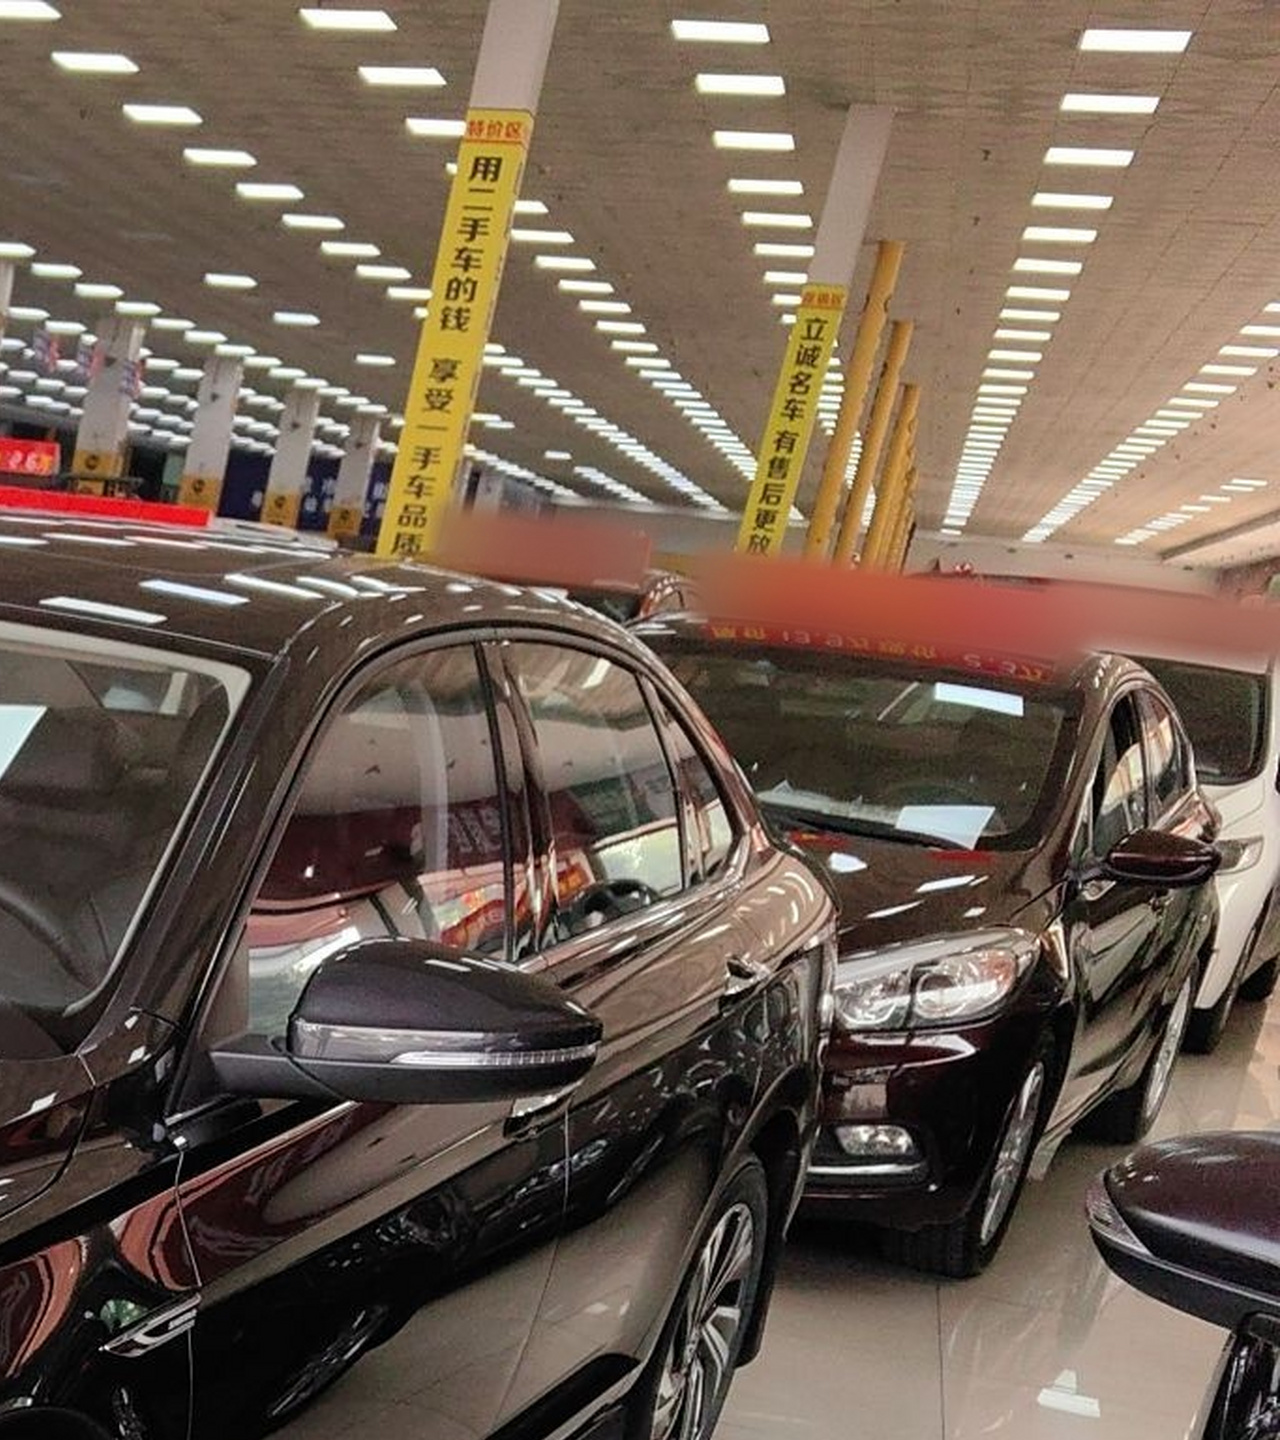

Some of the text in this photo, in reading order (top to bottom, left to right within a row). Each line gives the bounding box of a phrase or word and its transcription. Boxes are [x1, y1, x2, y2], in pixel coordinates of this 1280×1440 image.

[467, 119, 523, 138] 特价区
[391, 155, 503, 555] 用二手车的钱 享受一手车品质
[779, 317, 828, 422] 立诚名车
